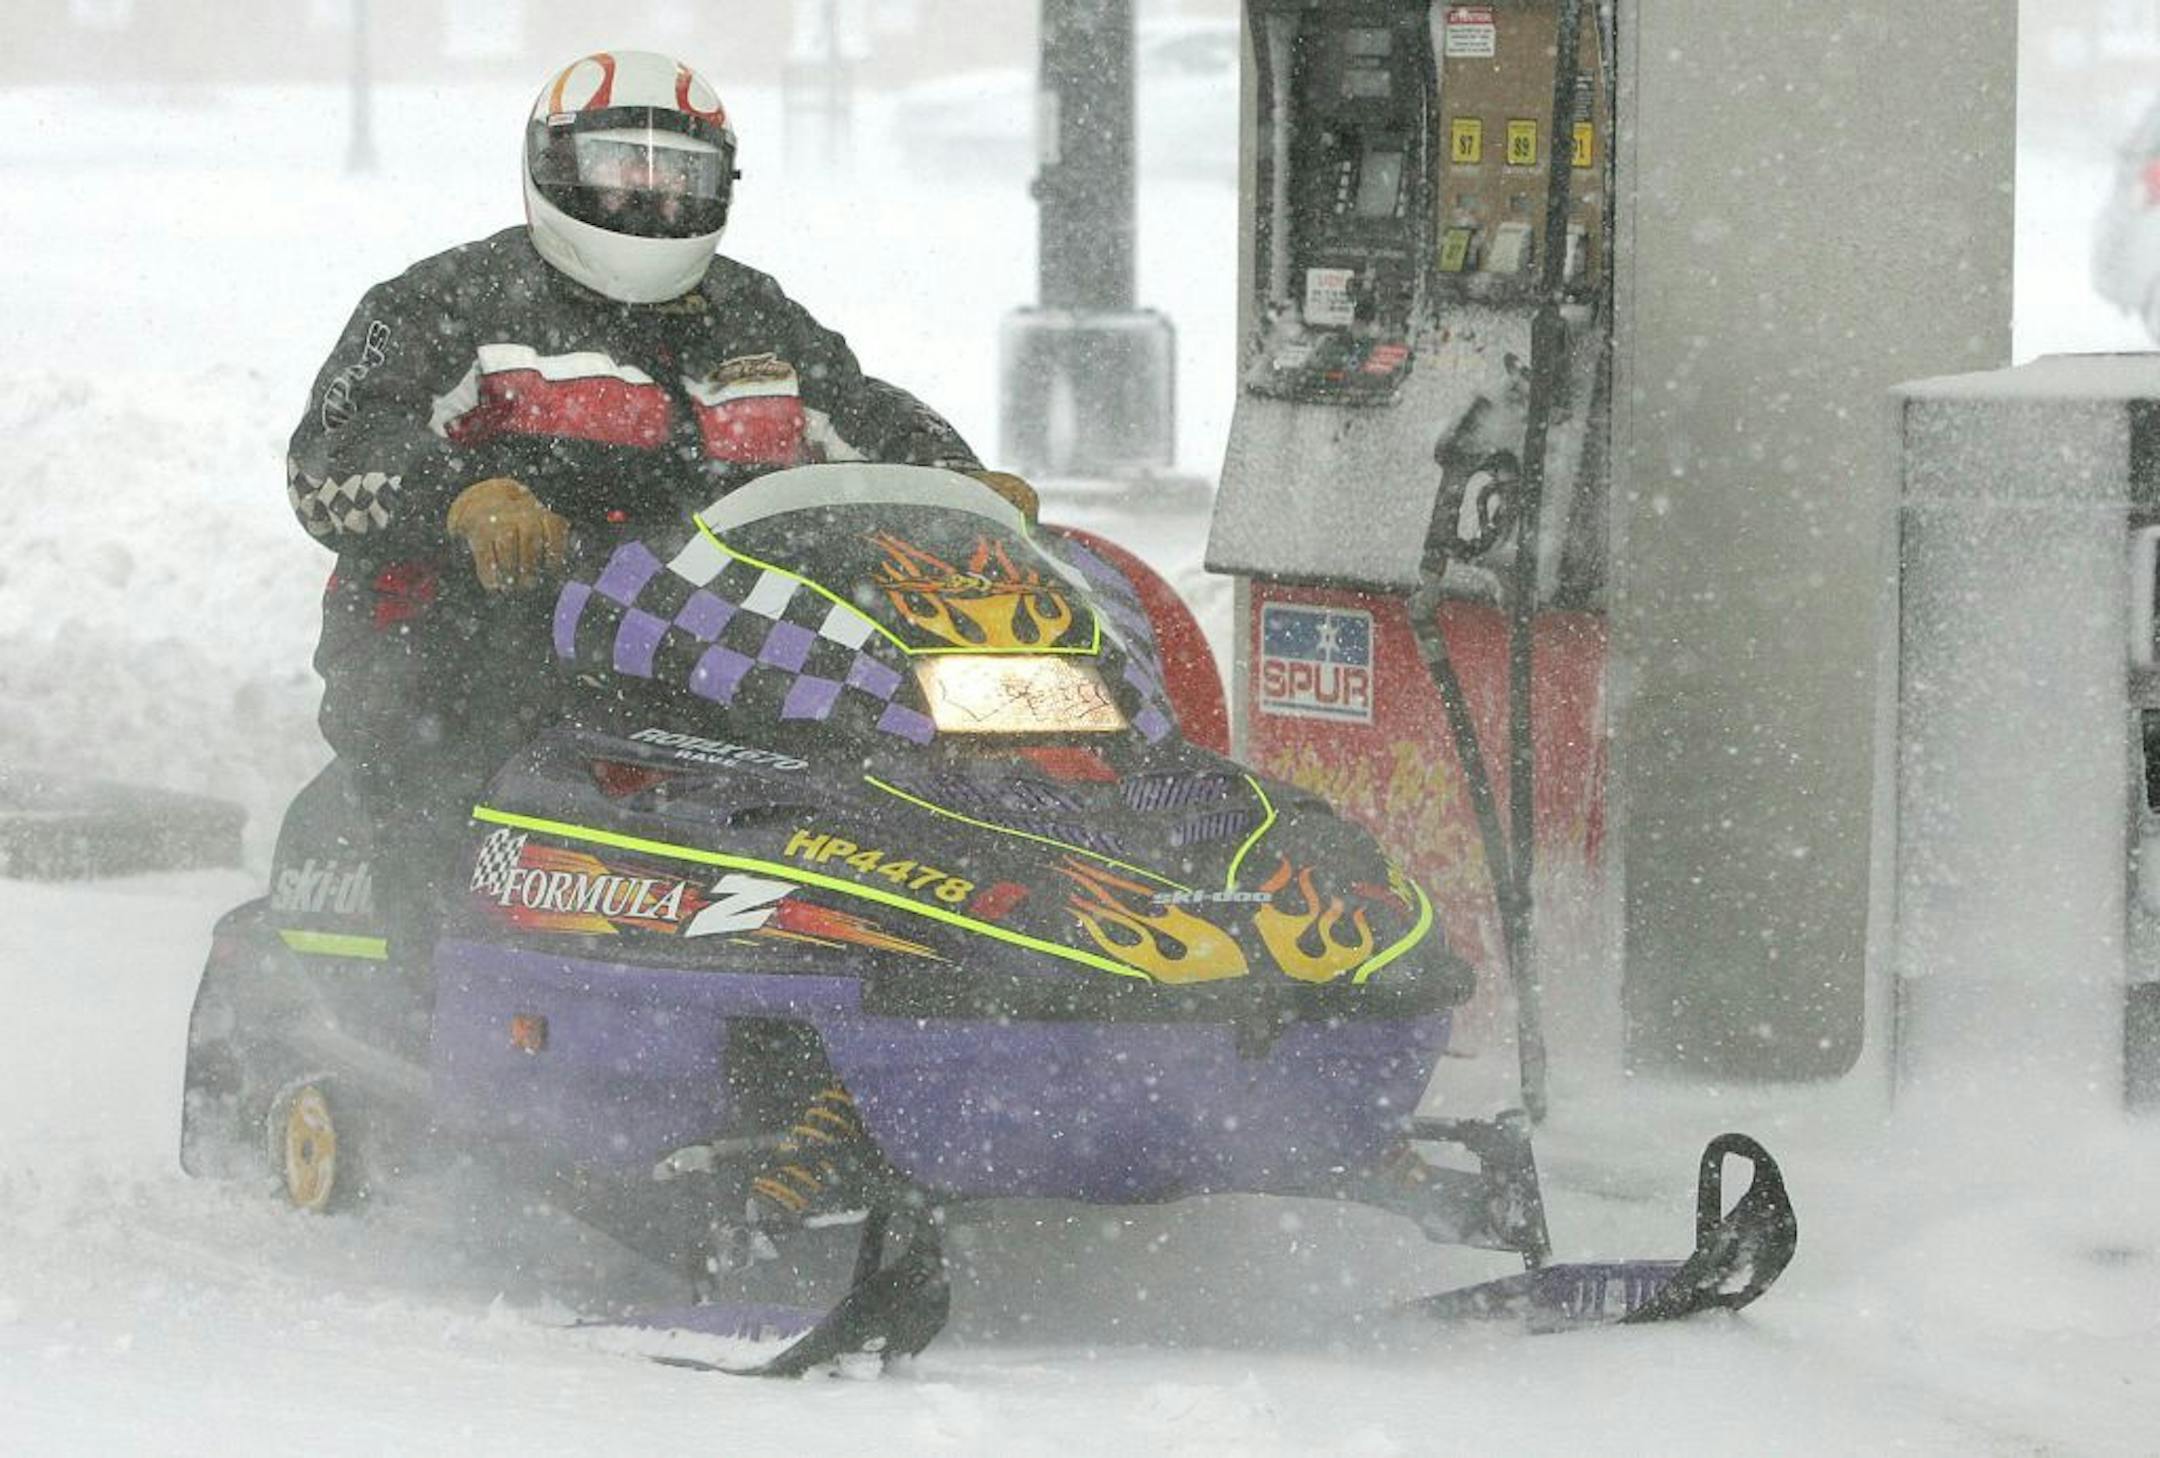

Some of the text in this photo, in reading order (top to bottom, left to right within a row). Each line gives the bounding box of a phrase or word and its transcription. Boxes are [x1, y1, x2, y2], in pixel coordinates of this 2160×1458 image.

[1459, 135, 1474, 156] 87
[1513, 136, 1530, 157] 89
[1264, 659, 1369, 707] SPUR
[783, 829, 975, 903] HP4478
[498, 868, 801, 938] FORMULA Z
